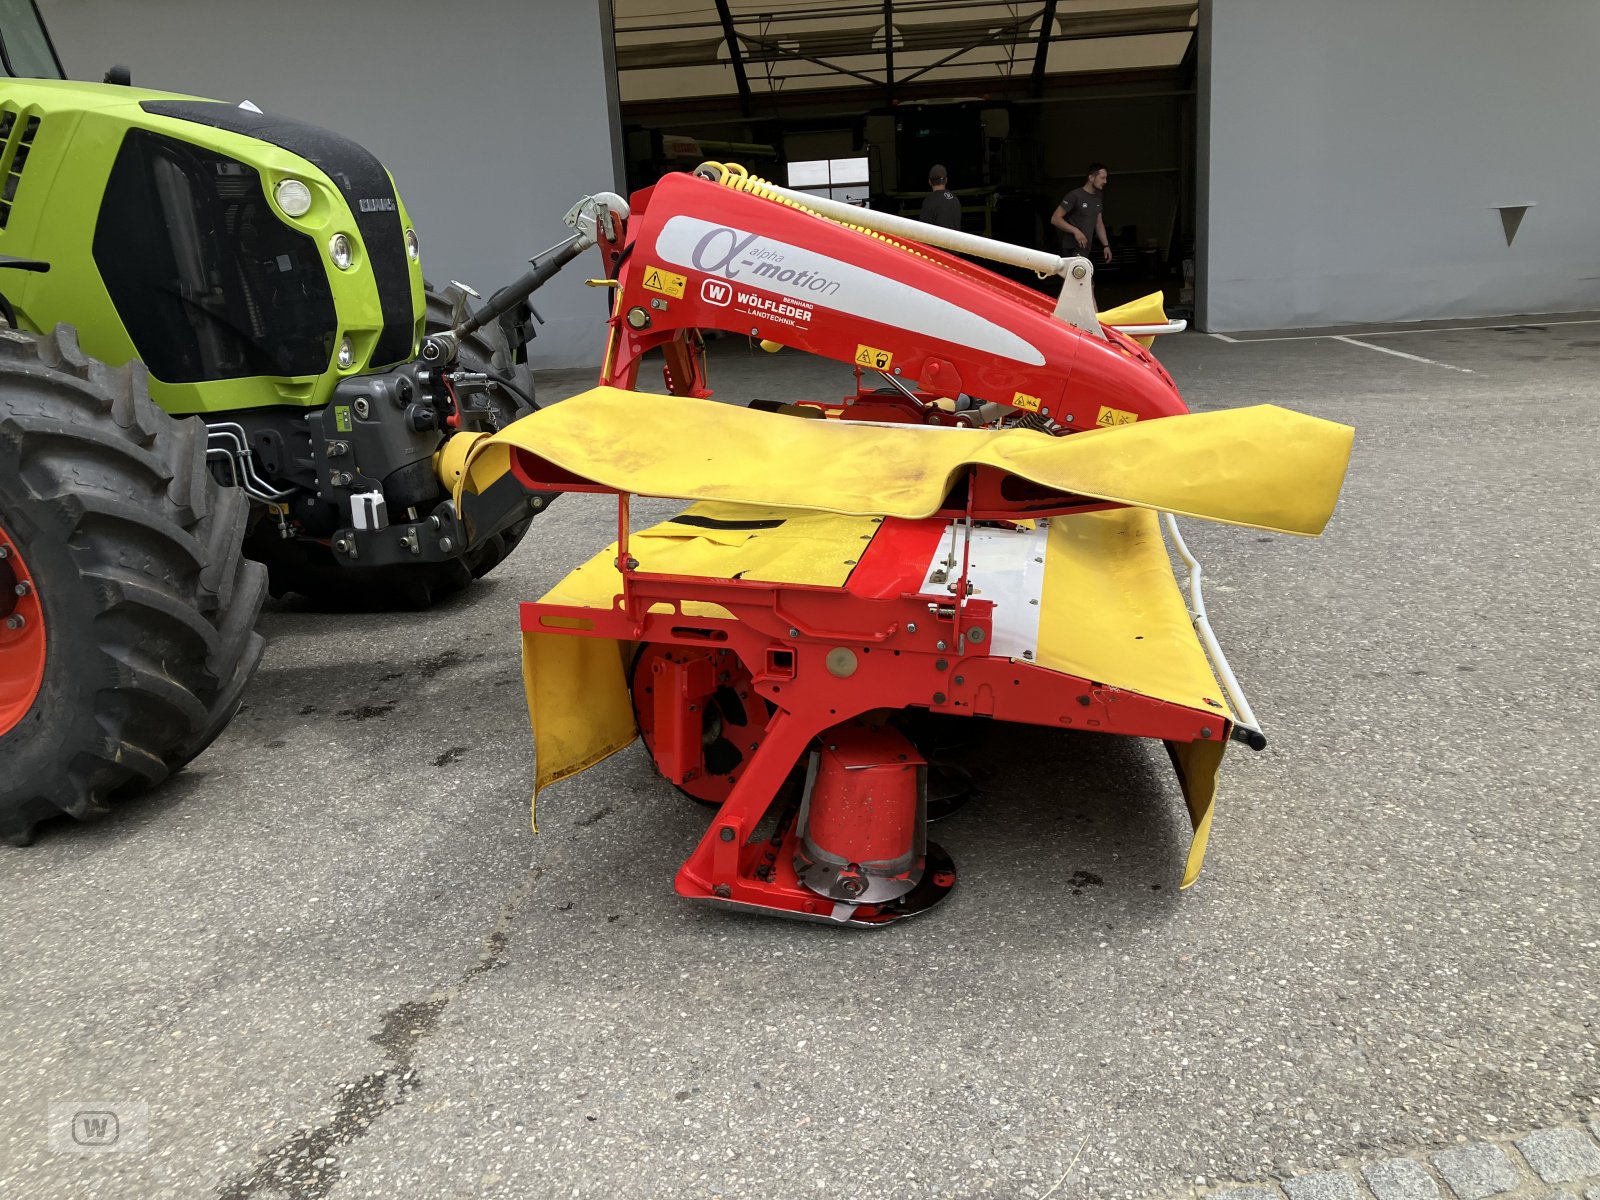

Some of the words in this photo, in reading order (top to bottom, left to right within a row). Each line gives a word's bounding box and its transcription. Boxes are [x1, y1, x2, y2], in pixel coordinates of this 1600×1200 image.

[749, 247, 785, 263] alpha
[737, 292, 813, 322] WÖLFLEDER
[783, 297, 814, 310] BERNHARD
[747, 308, 796, 327] LANDTECHNIK
